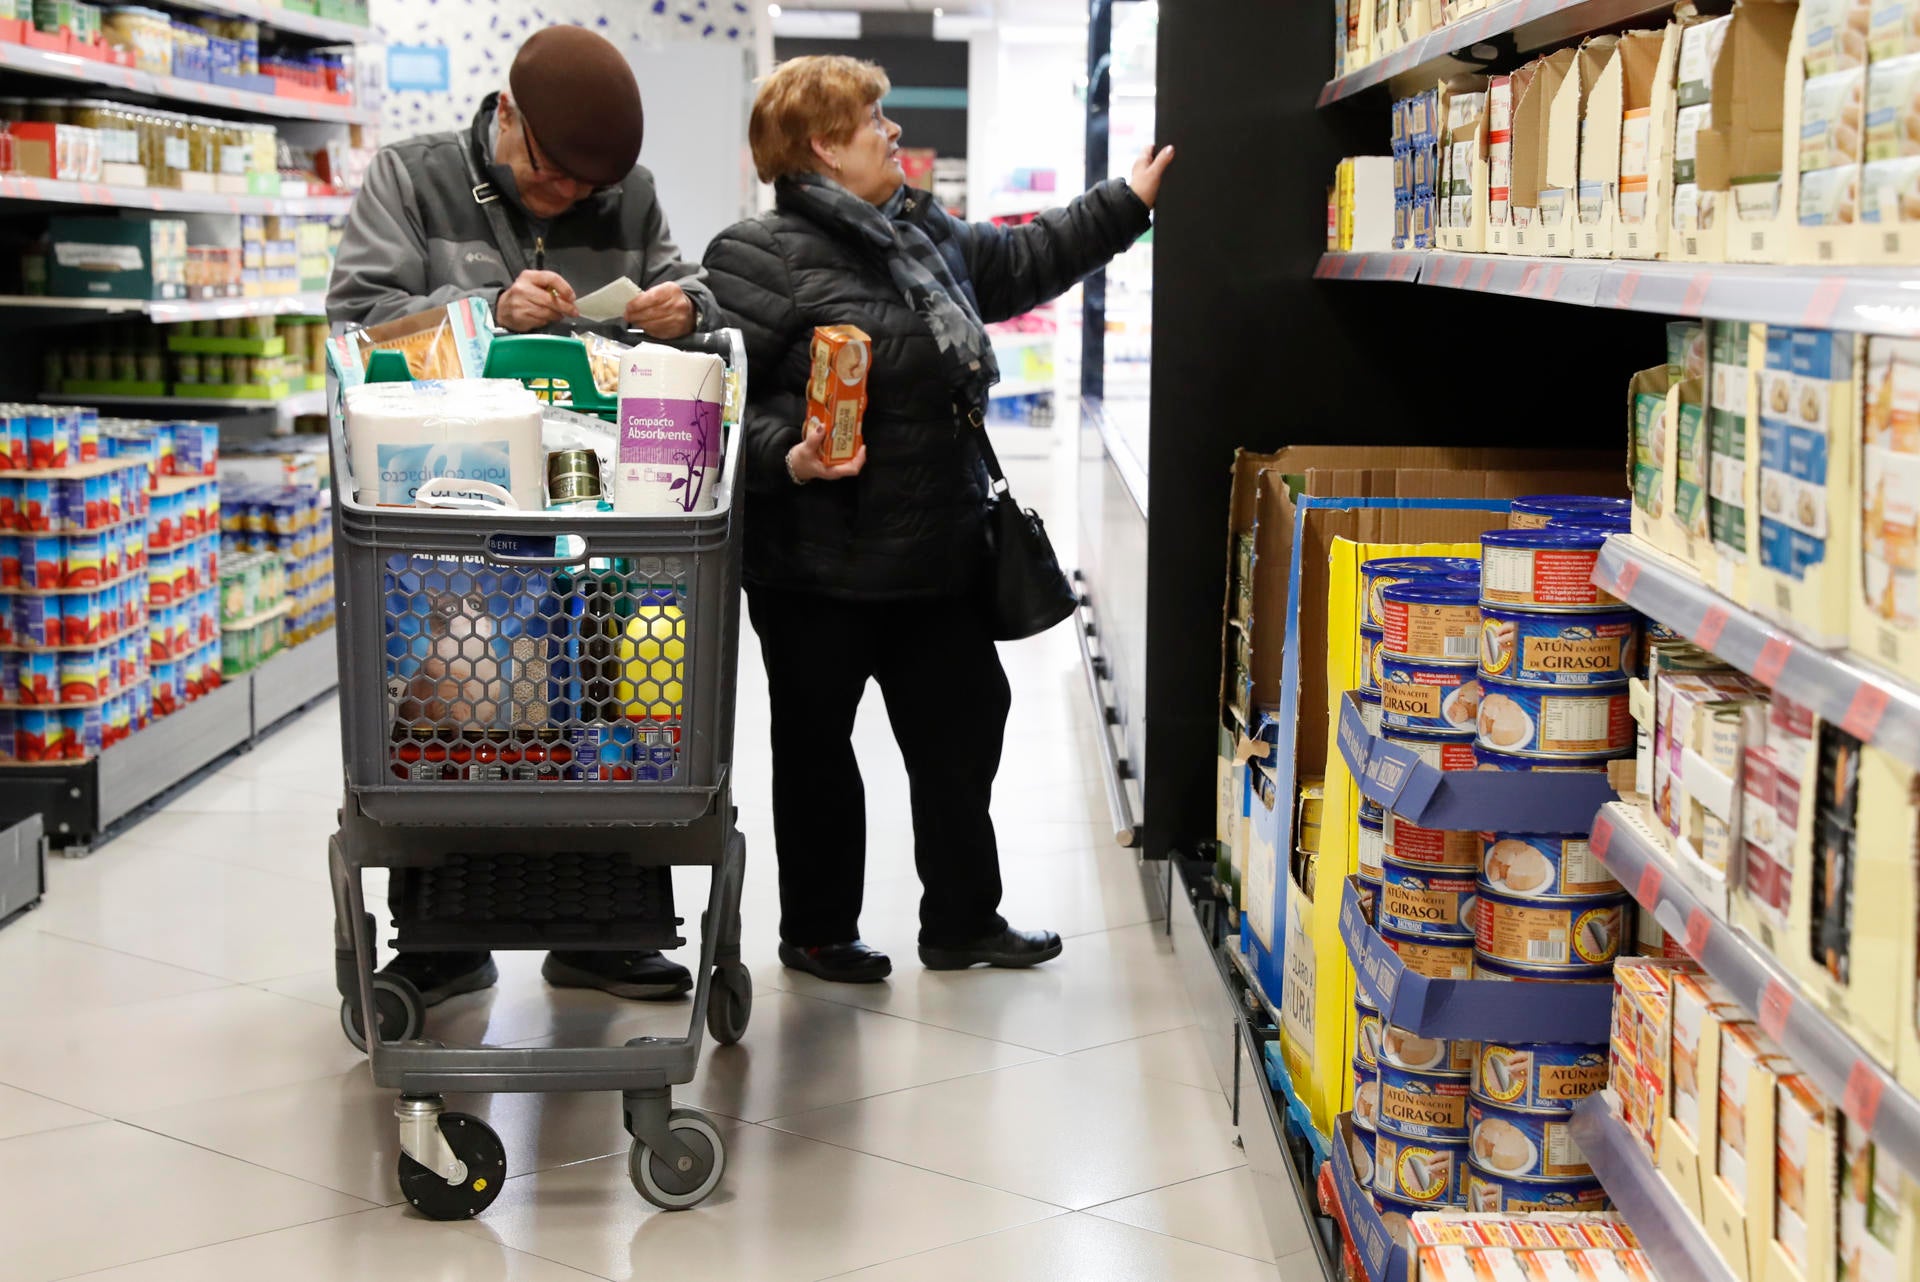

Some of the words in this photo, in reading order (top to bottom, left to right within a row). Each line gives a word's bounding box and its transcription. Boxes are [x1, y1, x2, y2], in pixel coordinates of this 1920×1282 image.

[628, 415, 674, 428] Compacto
[1534, 640, 1573, 652] ATÚN
[1543, 655, 1614, 669] GIRASOL
[1391, 901, 1448, 920] GIRASOL
[1551, 1068, 1588, 1080] ATÚN
[1392, 1104, 1455, 1124] GIRASOL
